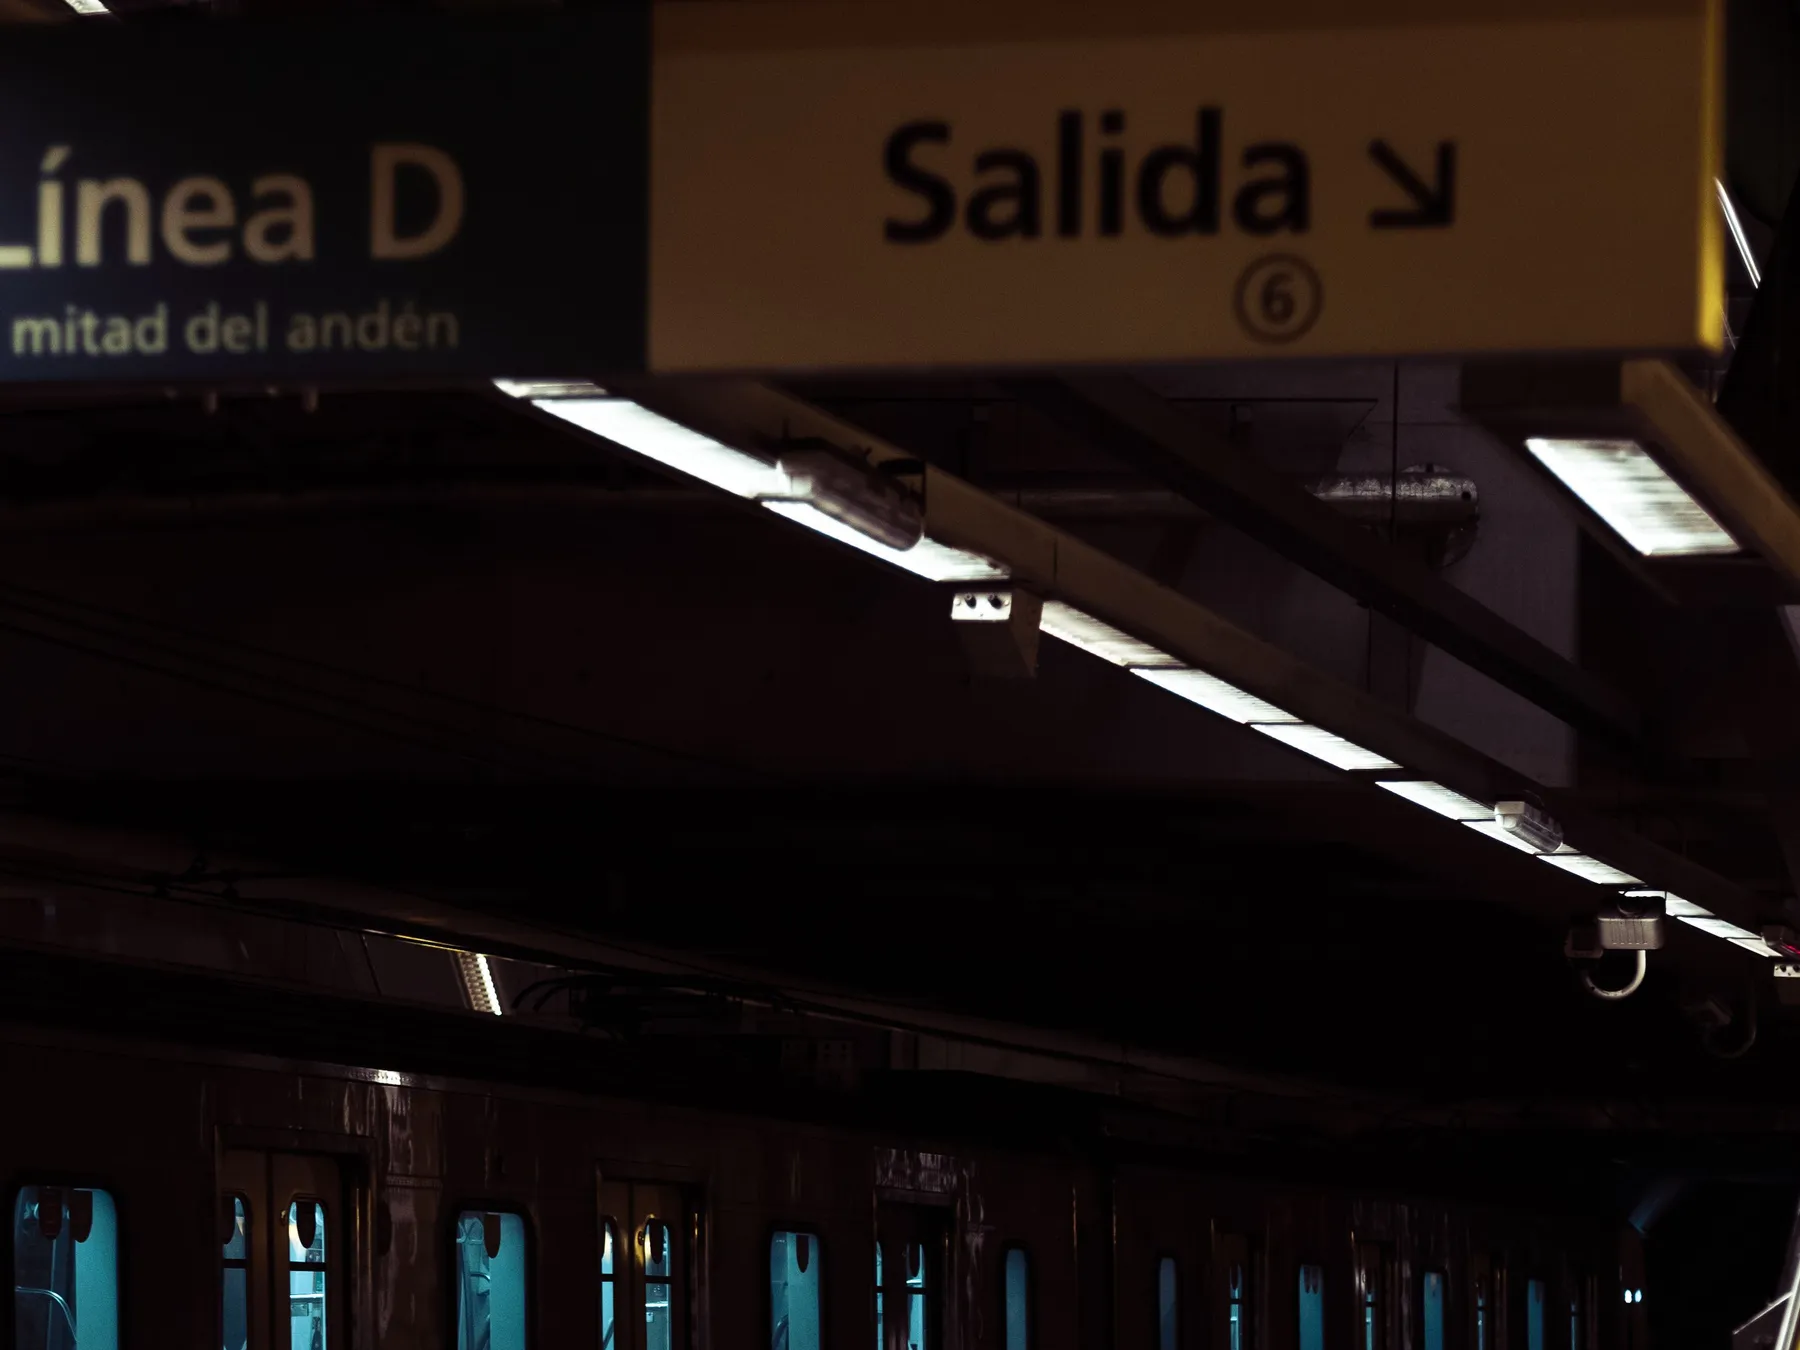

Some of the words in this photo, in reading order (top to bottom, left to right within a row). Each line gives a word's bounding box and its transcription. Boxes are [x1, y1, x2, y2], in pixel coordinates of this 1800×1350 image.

[367, 141, 468, 263] D
[882, 105, 1312, 245] Salida
[11, 301, 170, 358] mitad
[185, 300, 270, 355] del
[286, 297, 460, 353] andén
[1259, 270, 1297, 326] 6
